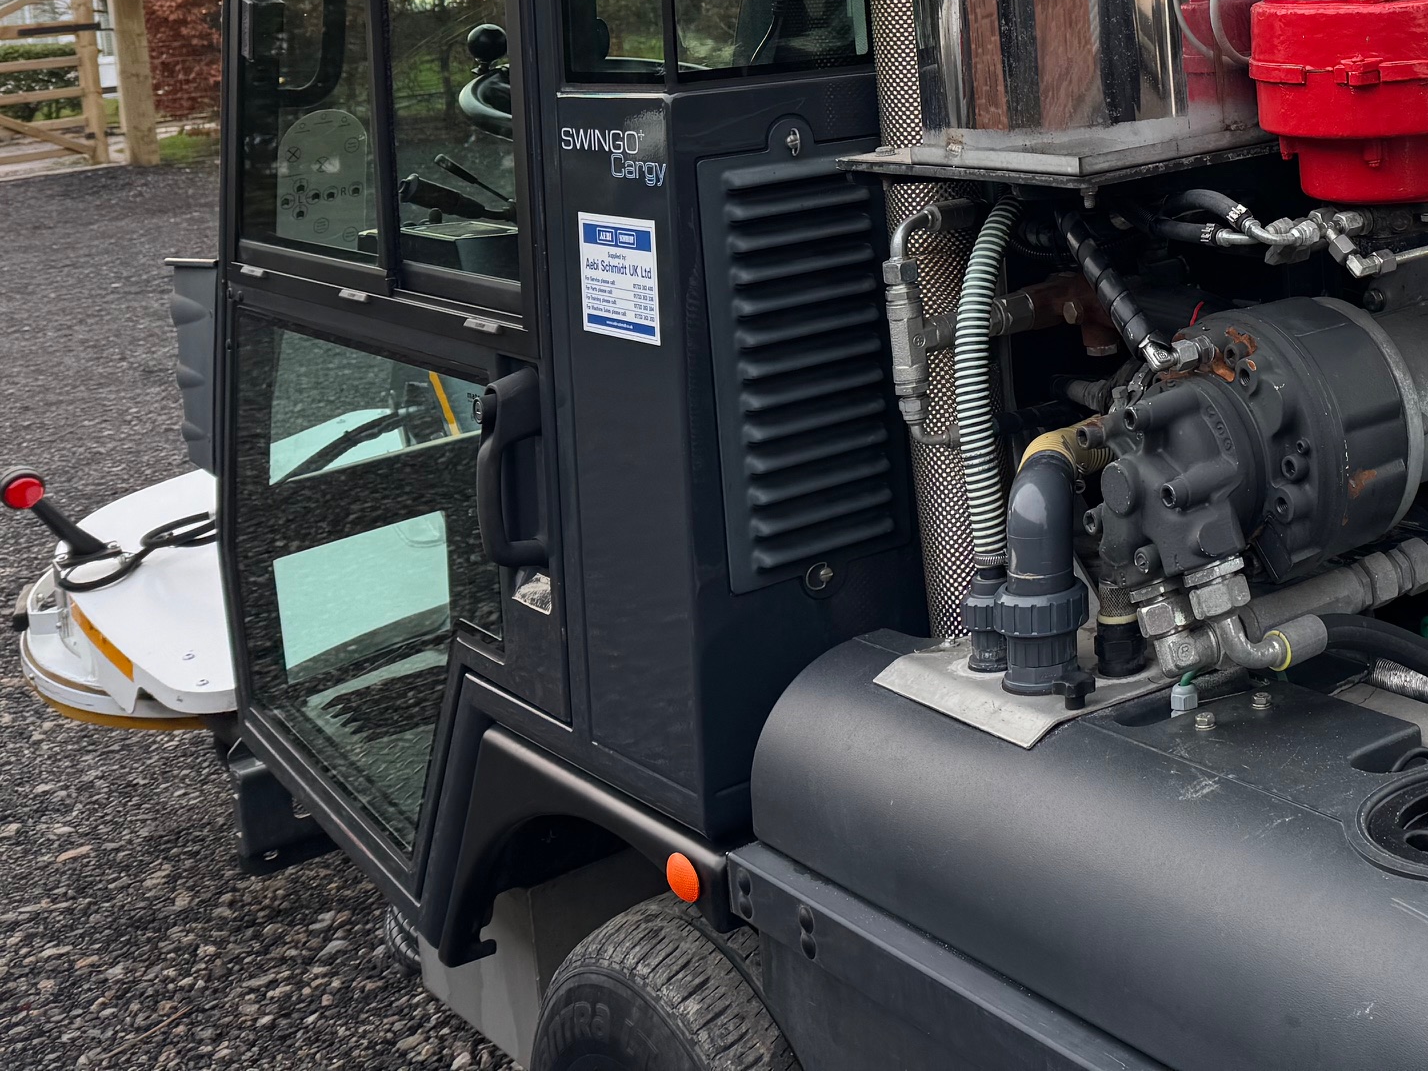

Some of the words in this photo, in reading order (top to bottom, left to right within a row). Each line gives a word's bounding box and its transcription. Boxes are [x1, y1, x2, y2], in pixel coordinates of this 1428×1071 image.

[611, 153, 667, 186] Cargy
[585, 257, 599, 271] Aebi
[601, 259, 627, 276] Schmidt
[628, 264, 639, 277] UK
[640, 266, 652, 279] Ltd
